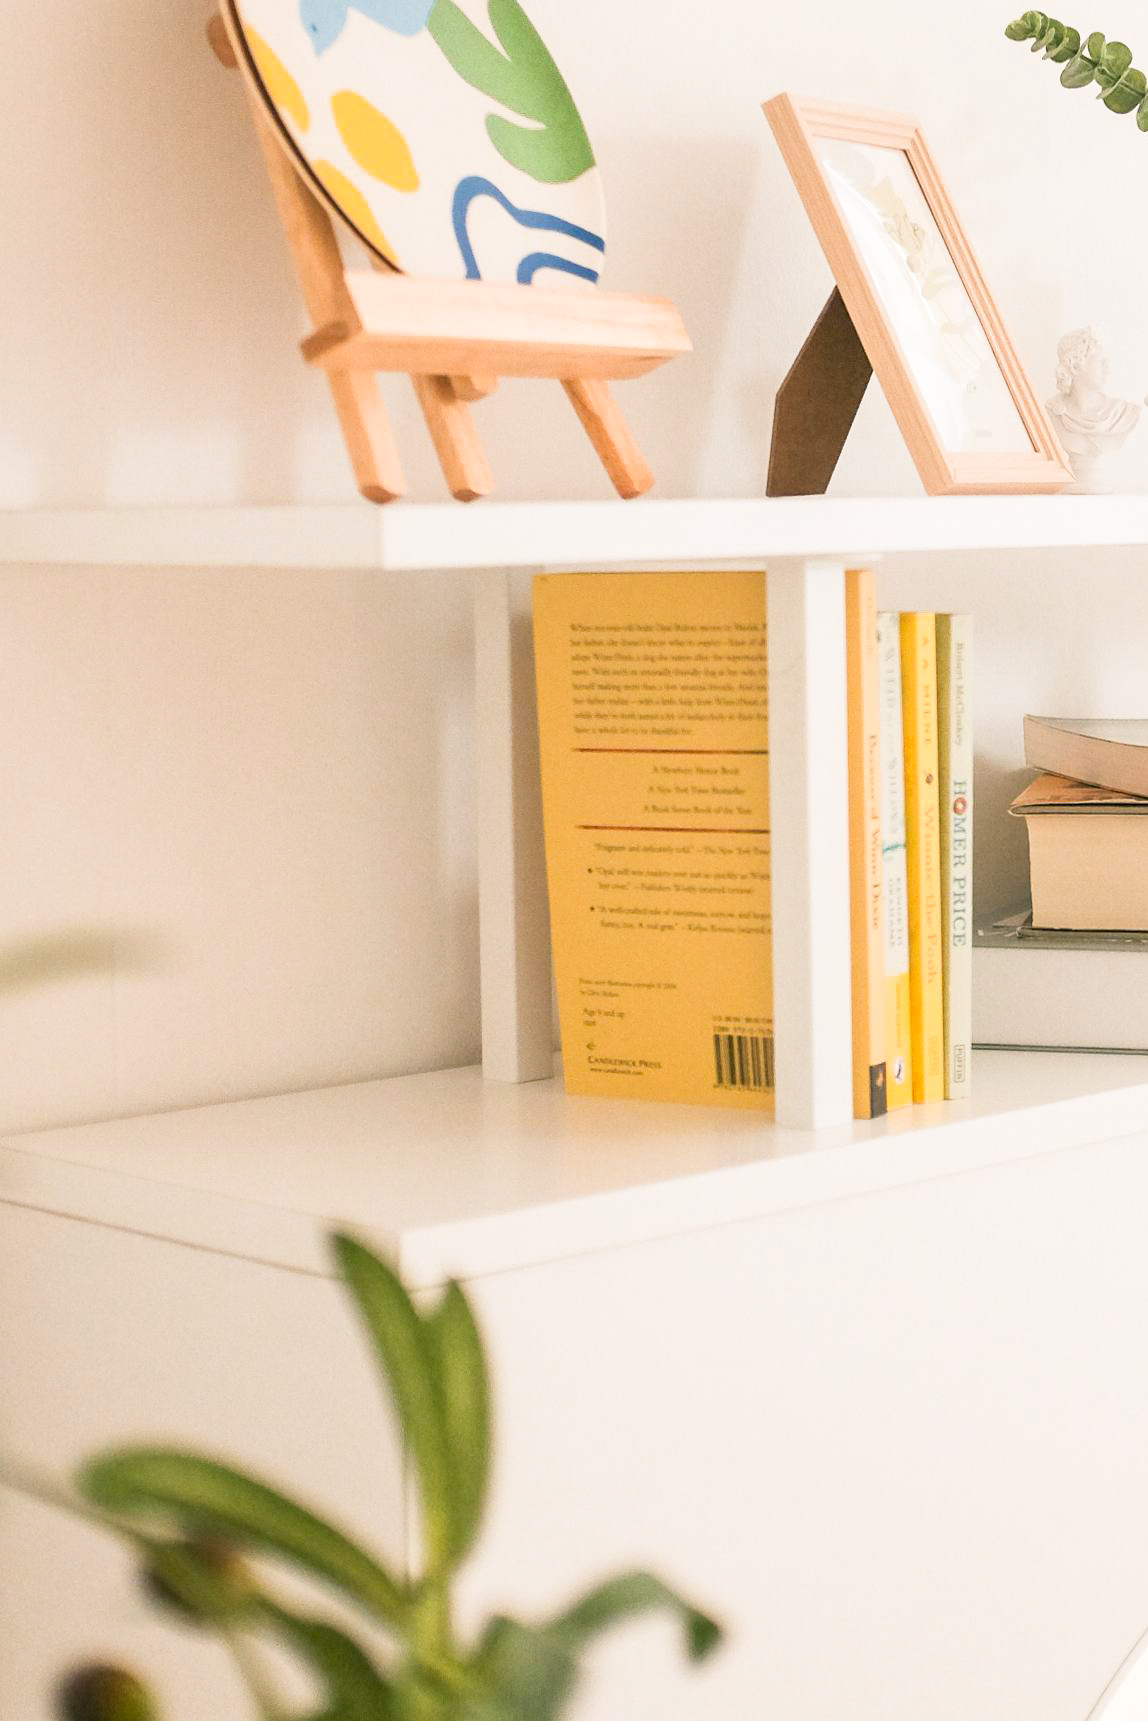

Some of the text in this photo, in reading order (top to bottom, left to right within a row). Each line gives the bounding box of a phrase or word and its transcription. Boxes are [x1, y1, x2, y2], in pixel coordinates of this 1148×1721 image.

[955, 642, 965, 681] Robert
[953, 780, 967, 948] HOMER PRICE
